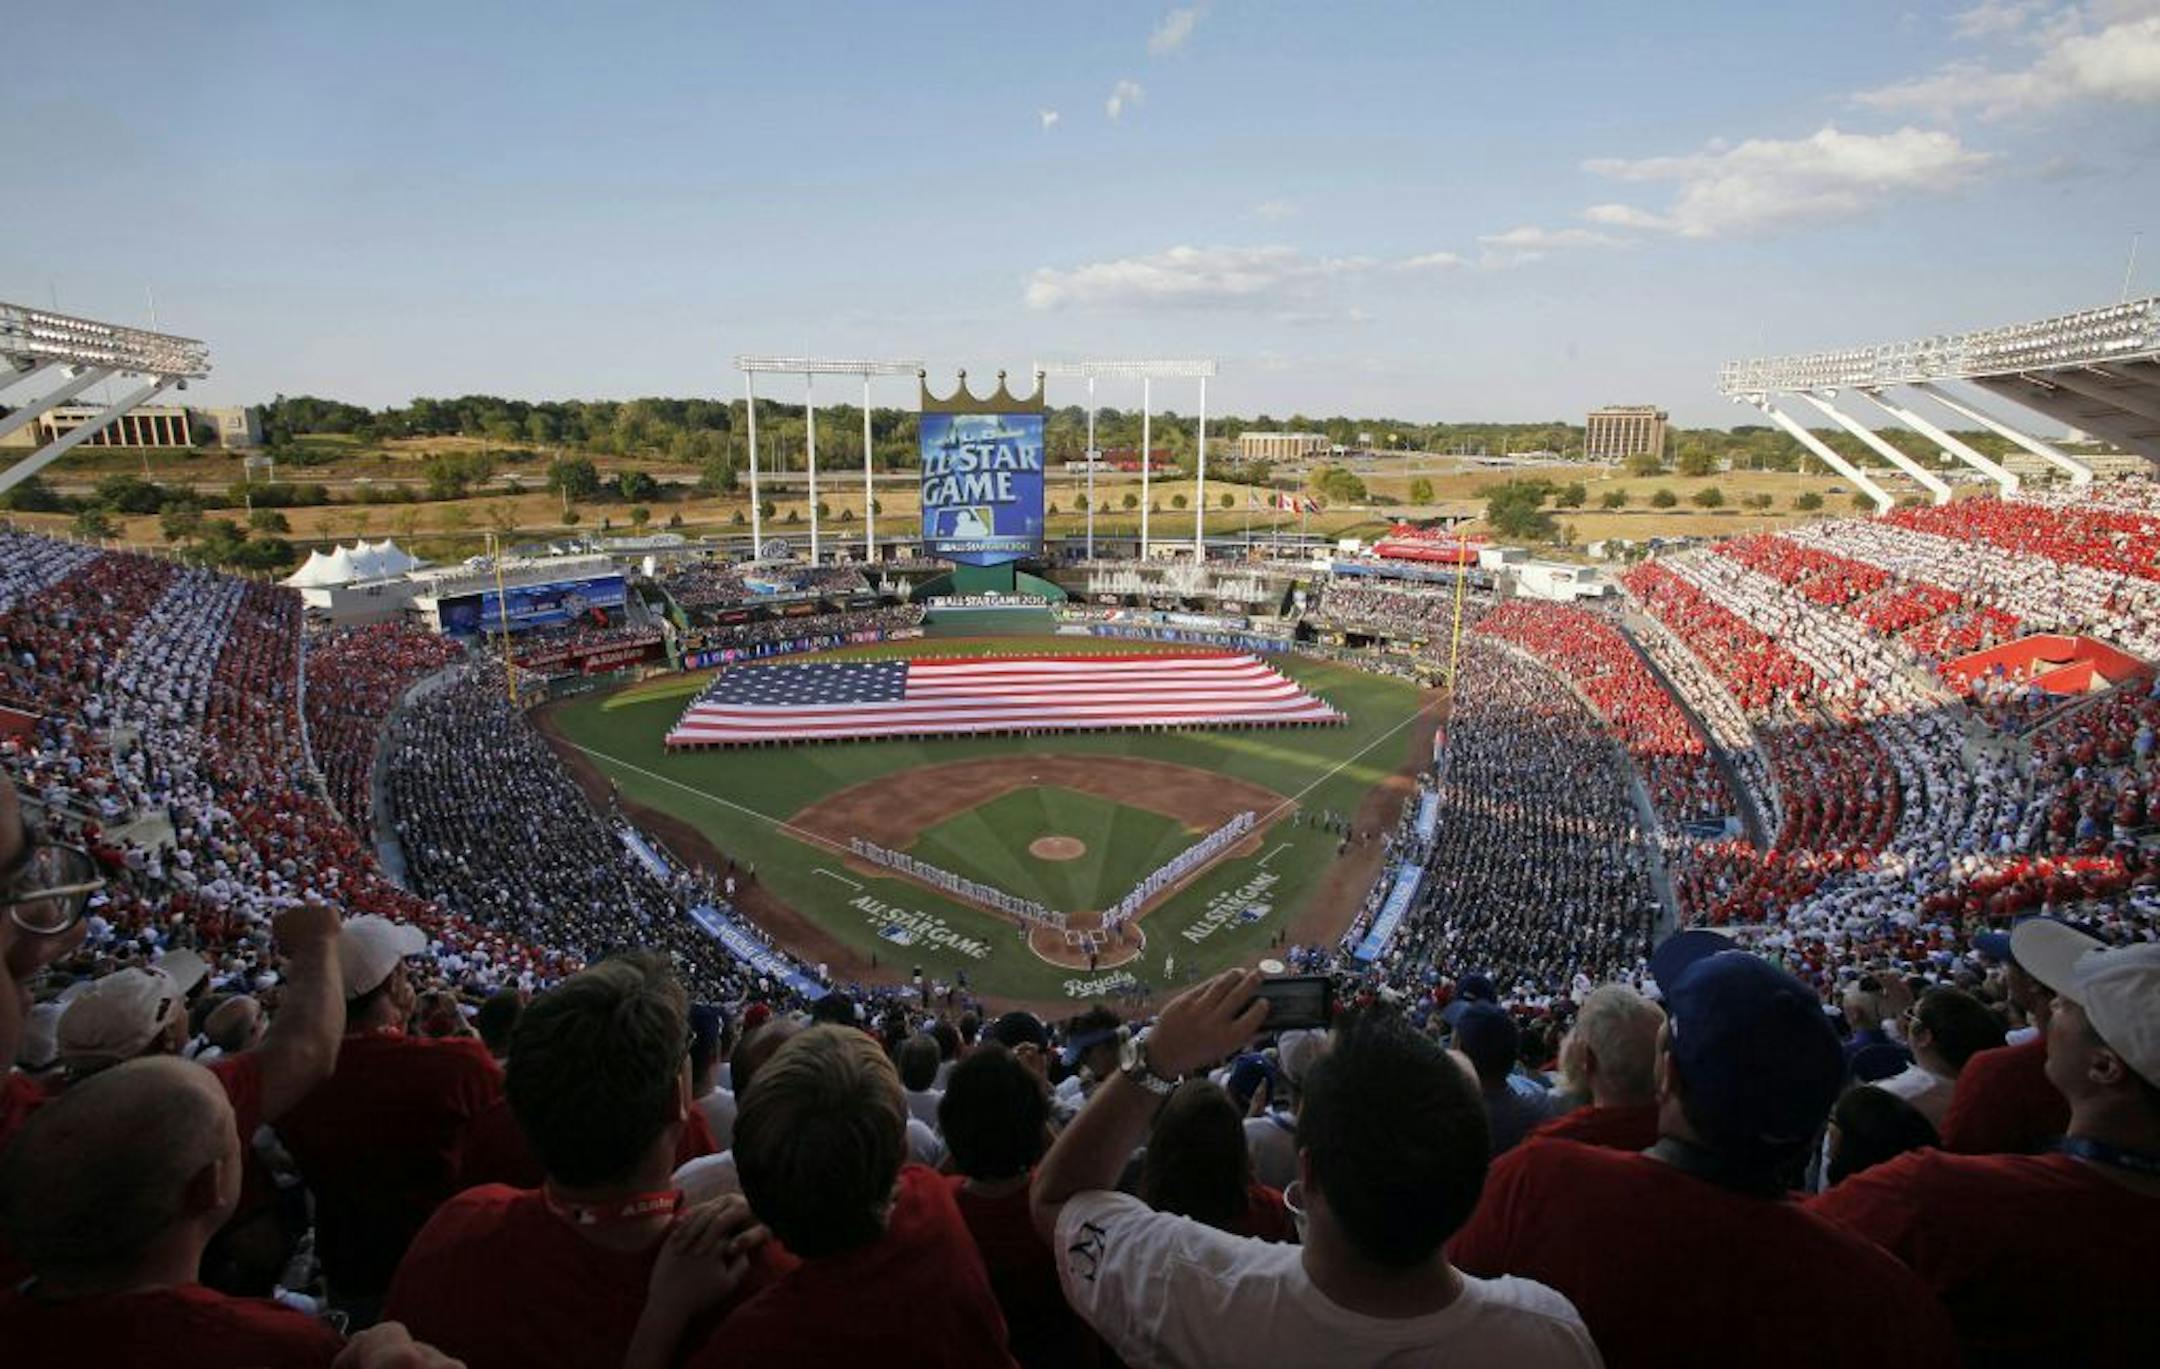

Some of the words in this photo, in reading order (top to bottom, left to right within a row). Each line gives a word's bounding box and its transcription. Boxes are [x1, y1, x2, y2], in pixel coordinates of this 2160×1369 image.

[959, 443, 1041, 472] STAR
[923, 472, 1016, 506] GAME
[1063, 969, 1138, 998] Royals
